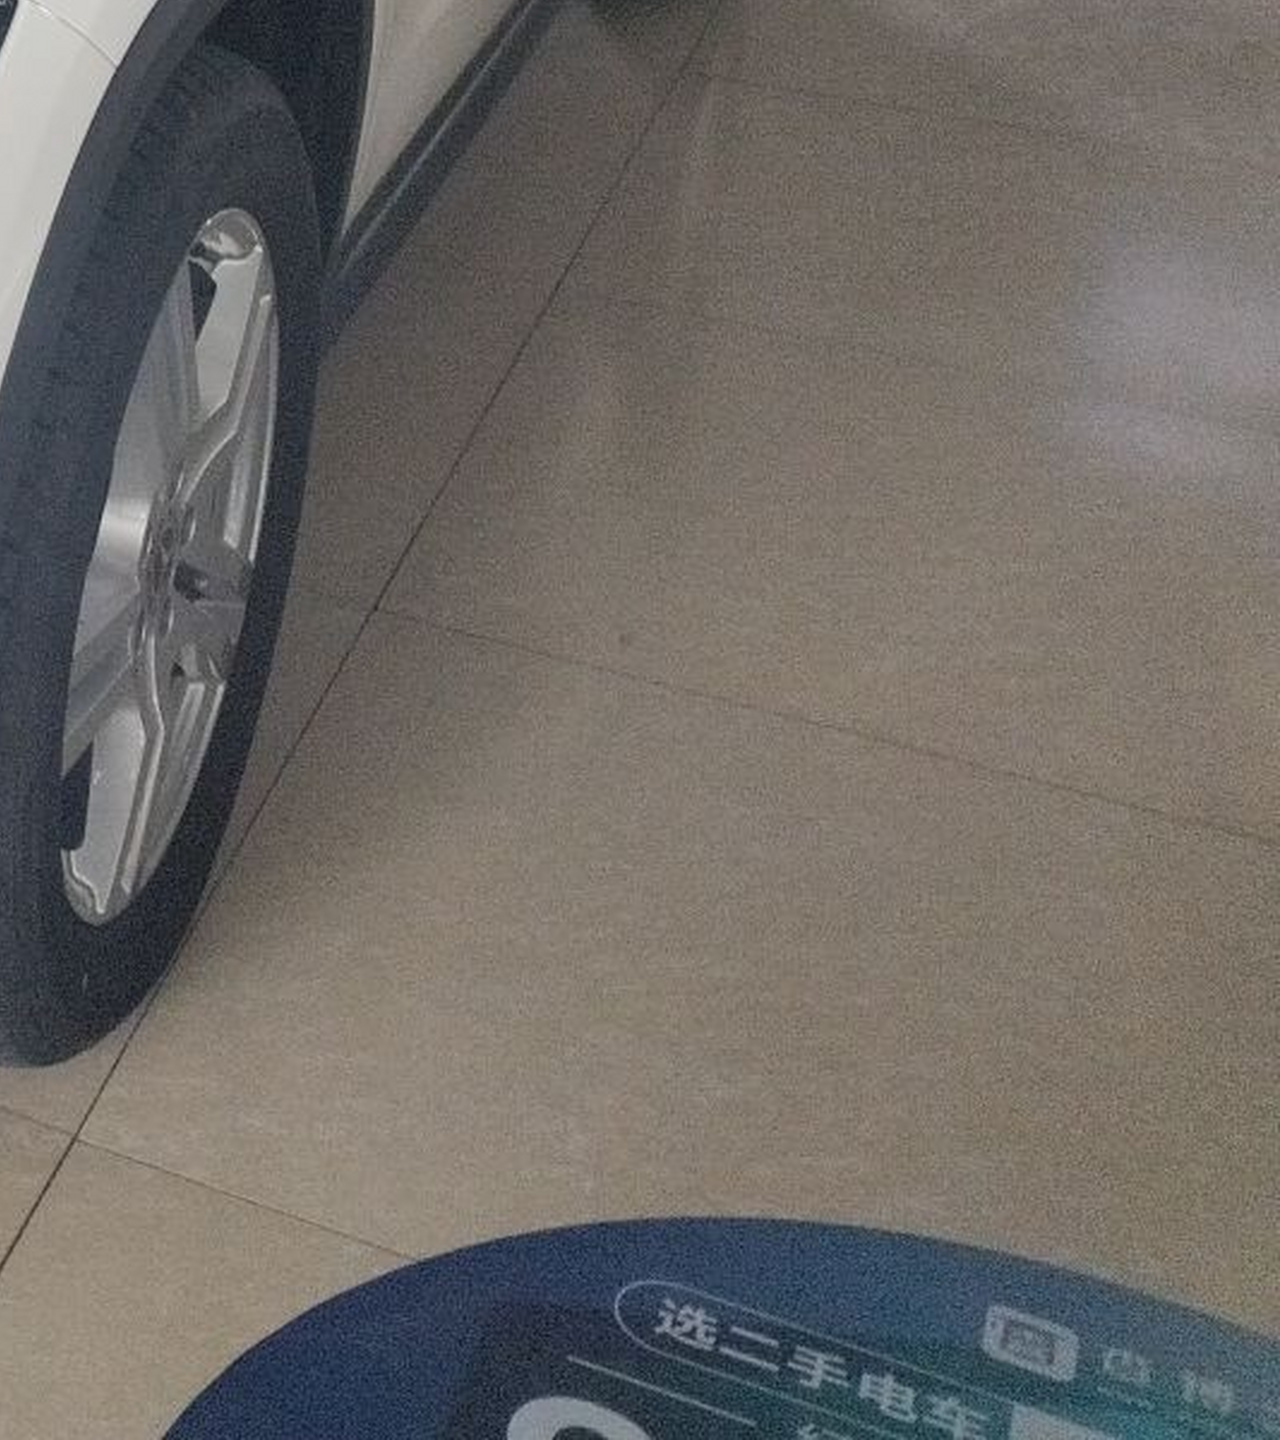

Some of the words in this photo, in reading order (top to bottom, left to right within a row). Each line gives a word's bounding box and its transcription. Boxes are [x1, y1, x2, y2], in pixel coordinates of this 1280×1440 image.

[654, 1298, 991, 1440] 选二手电车
